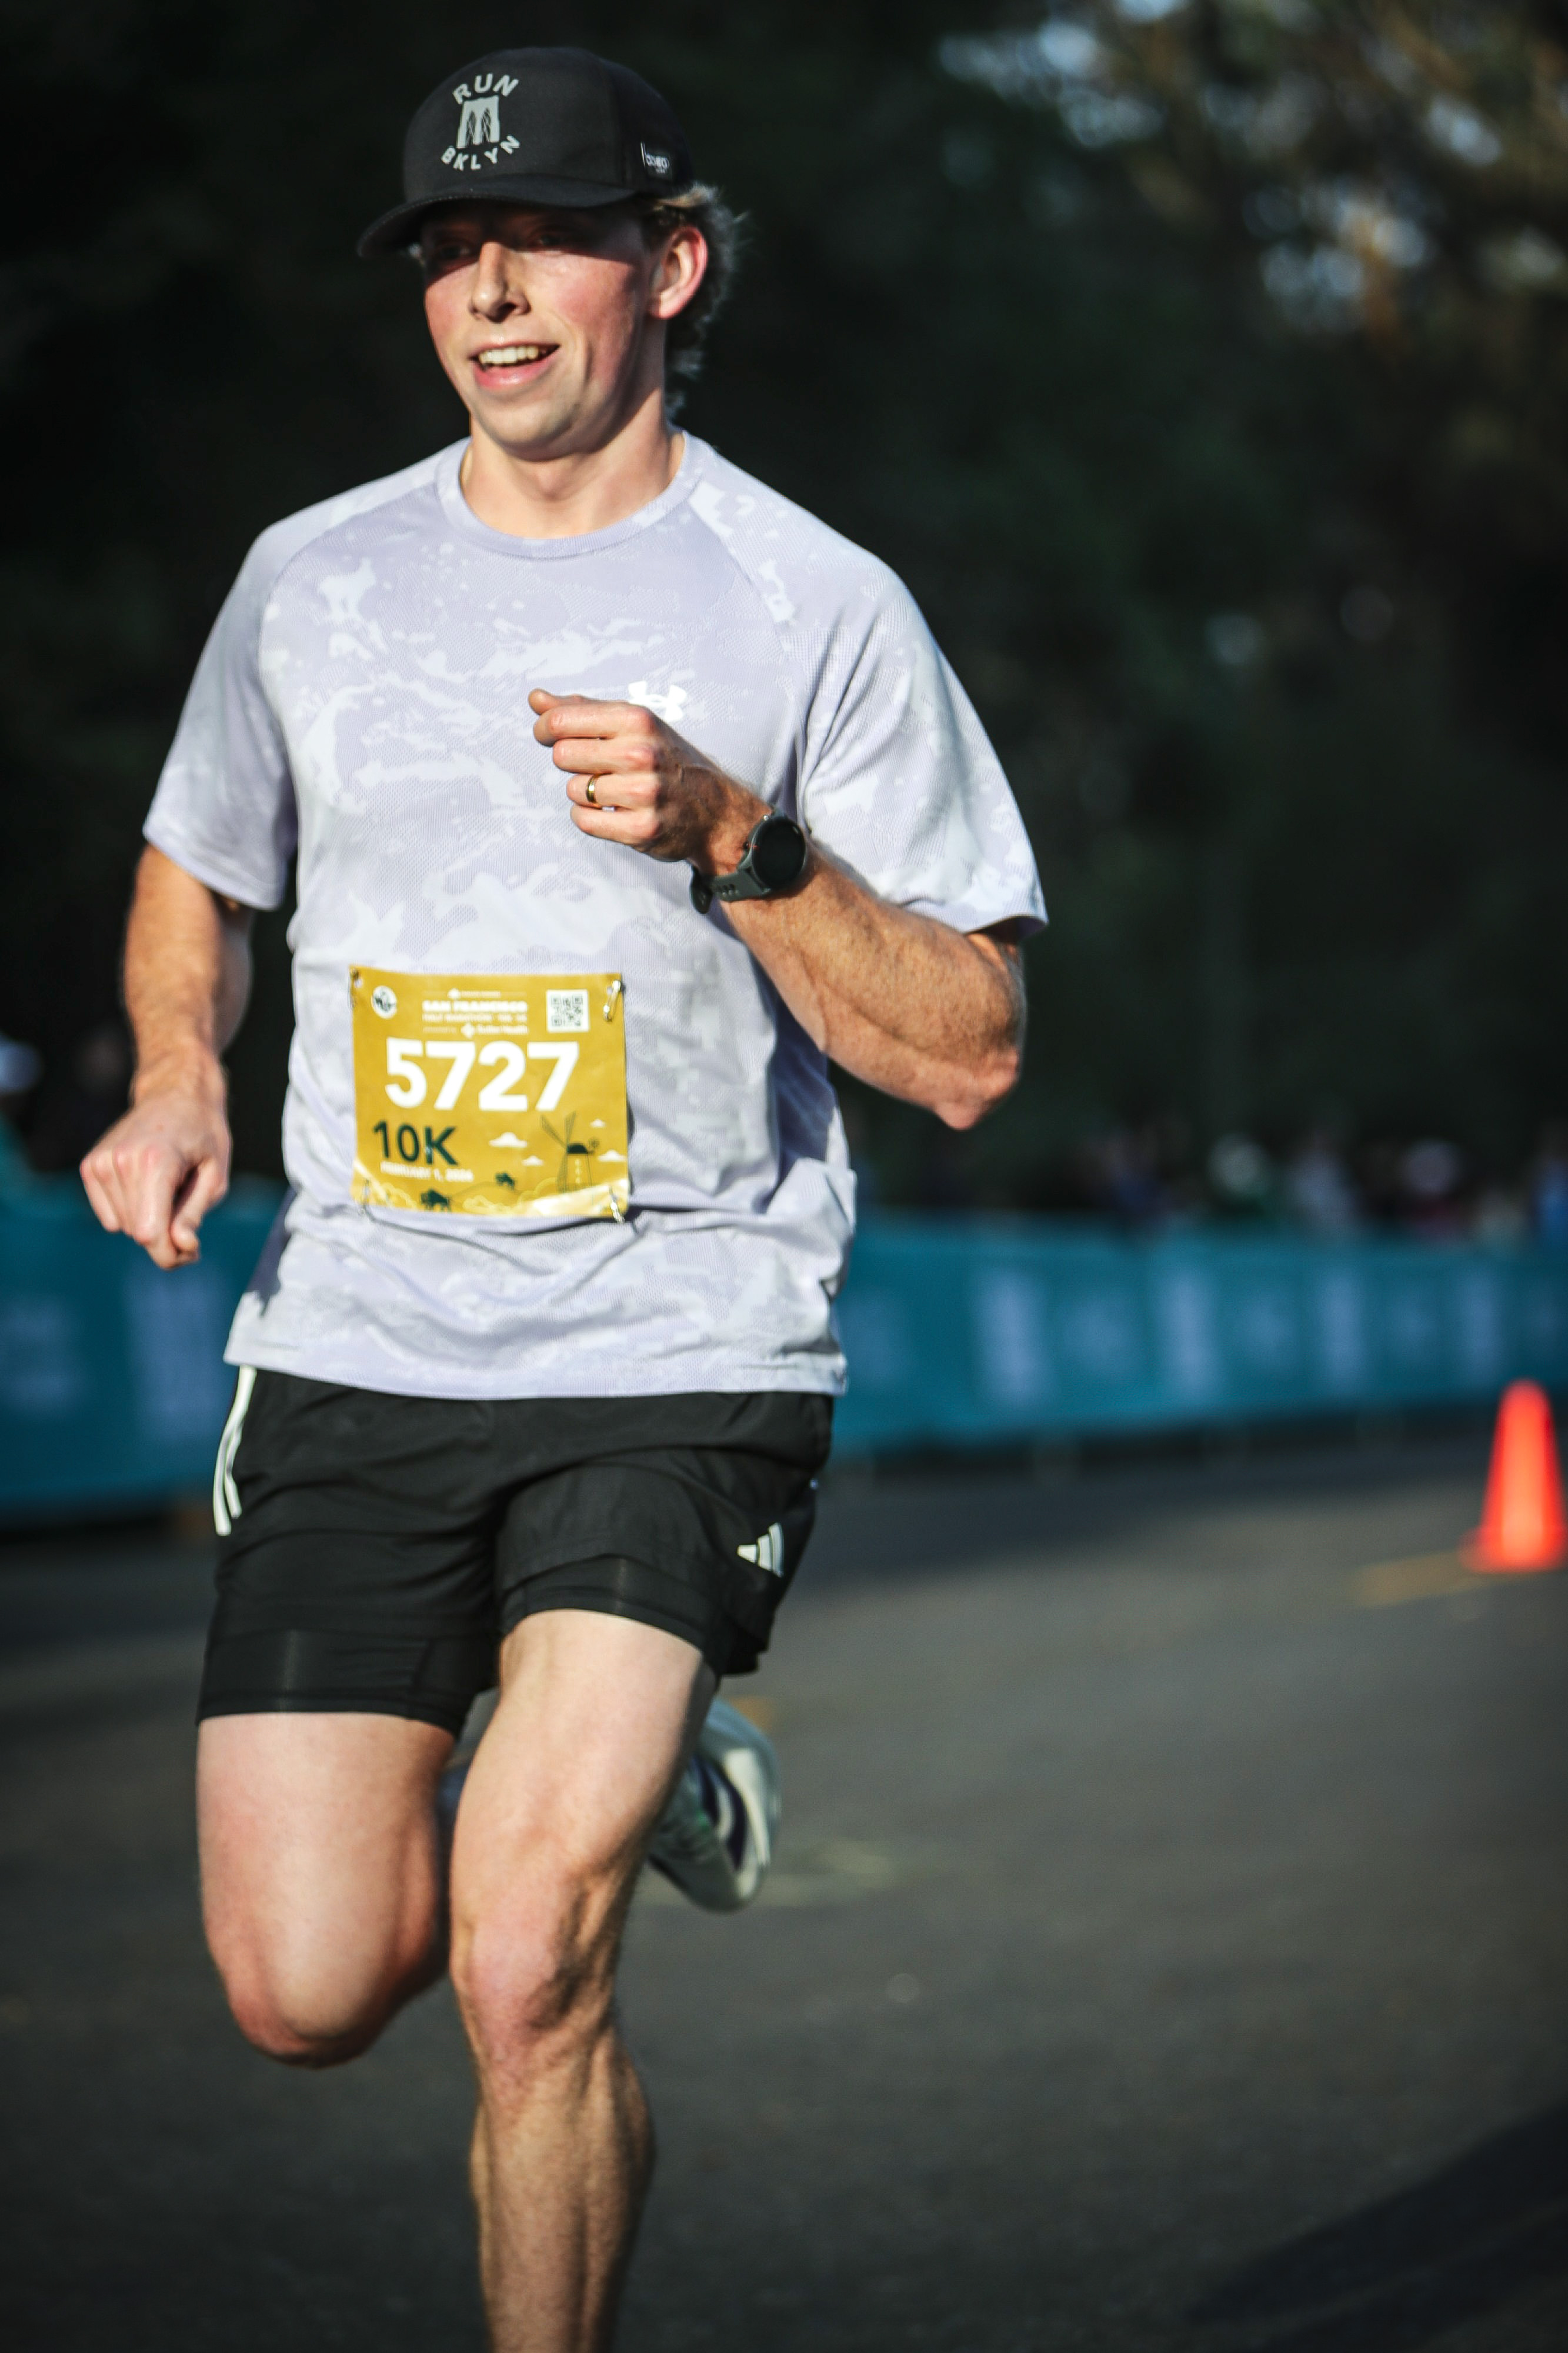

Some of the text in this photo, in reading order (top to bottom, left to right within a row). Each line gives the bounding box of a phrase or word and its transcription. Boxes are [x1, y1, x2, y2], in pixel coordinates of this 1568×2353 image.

[452, 73, 519, 105] RUN
[441, 135, 520, 171] BKLYN
[385, 1037, 579, 1112] 5727
[373, 1120, 458, 1166] 10K
